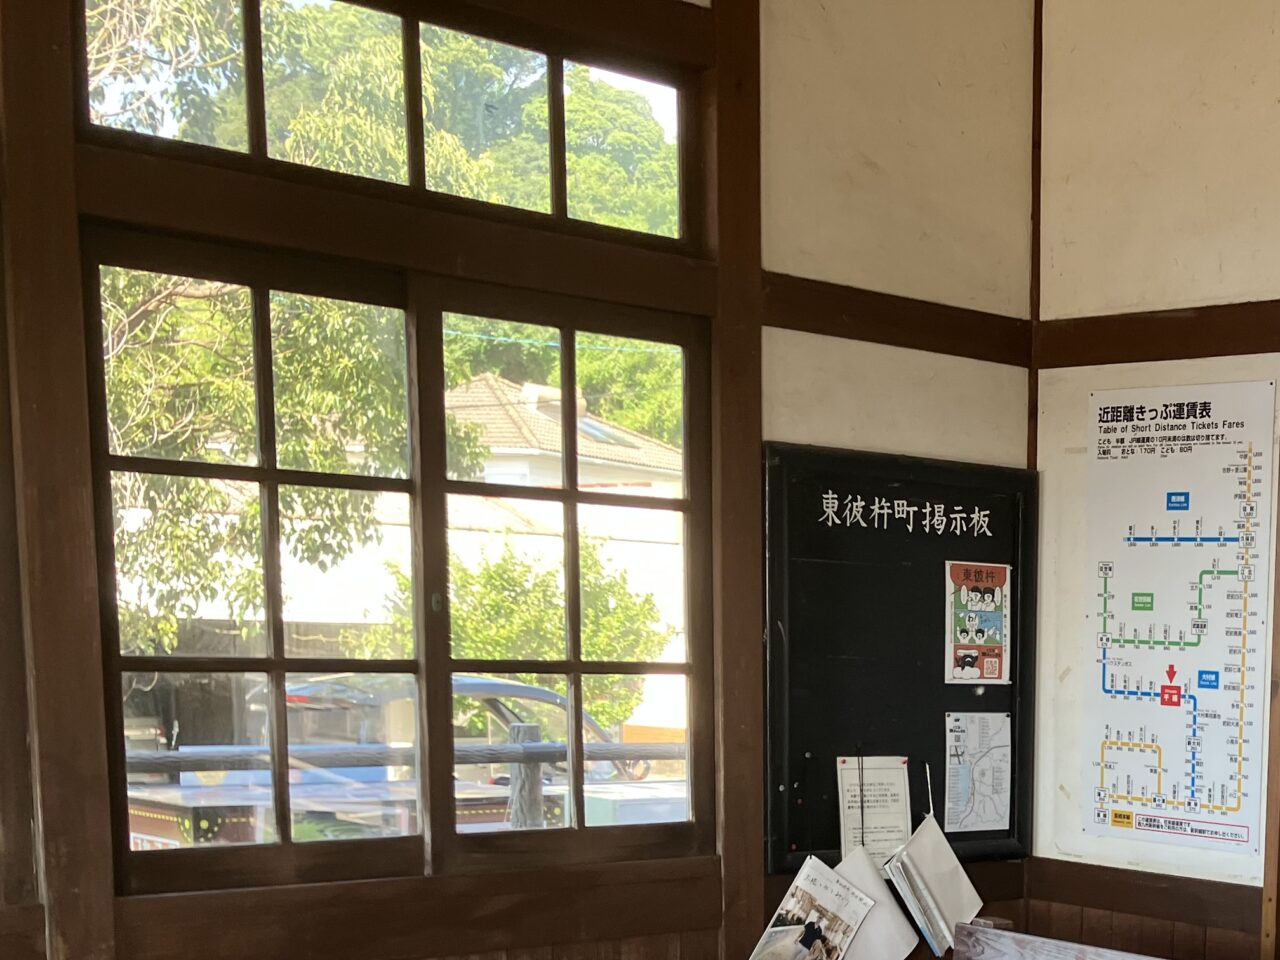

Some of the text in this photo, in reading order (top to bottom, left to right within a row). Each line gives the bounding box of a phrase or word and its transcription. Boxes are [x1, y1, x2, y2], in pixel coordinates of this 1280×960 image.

[1098, 401, 1211, 423] 近距離きっぷ運賃表
[1098, 419, 1245, 434] Table of Short Distance Tickets Fares
[817, 489, 993, 537] 東彼杵町掲示板
[962, 568, 996, 583] 東彼杵
